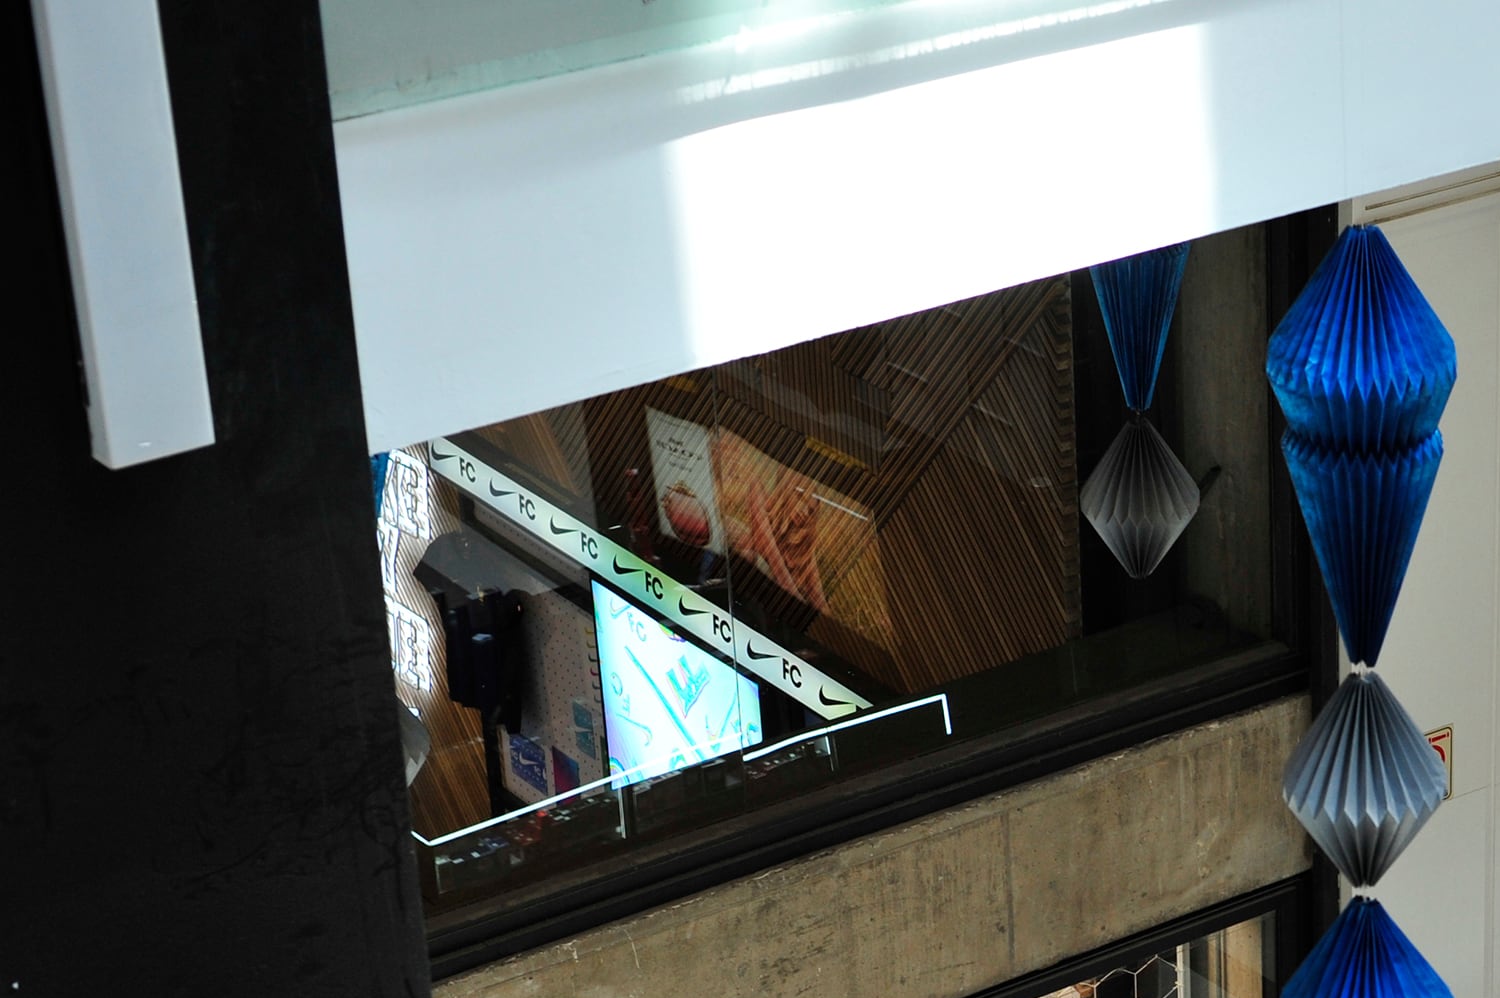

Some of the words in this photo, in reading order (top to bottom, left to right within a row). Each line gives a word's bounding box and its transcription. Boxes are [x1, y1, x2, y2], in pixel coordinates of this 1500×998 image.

[458, 456, 477, 483] FC
[518, 493, 536, 521] FC
[580, 531, 599, 560] FC
[644, 570, 664, 600] FC
[712, 613, 733, 644] FC
[781, 657, 803, 689] FC
